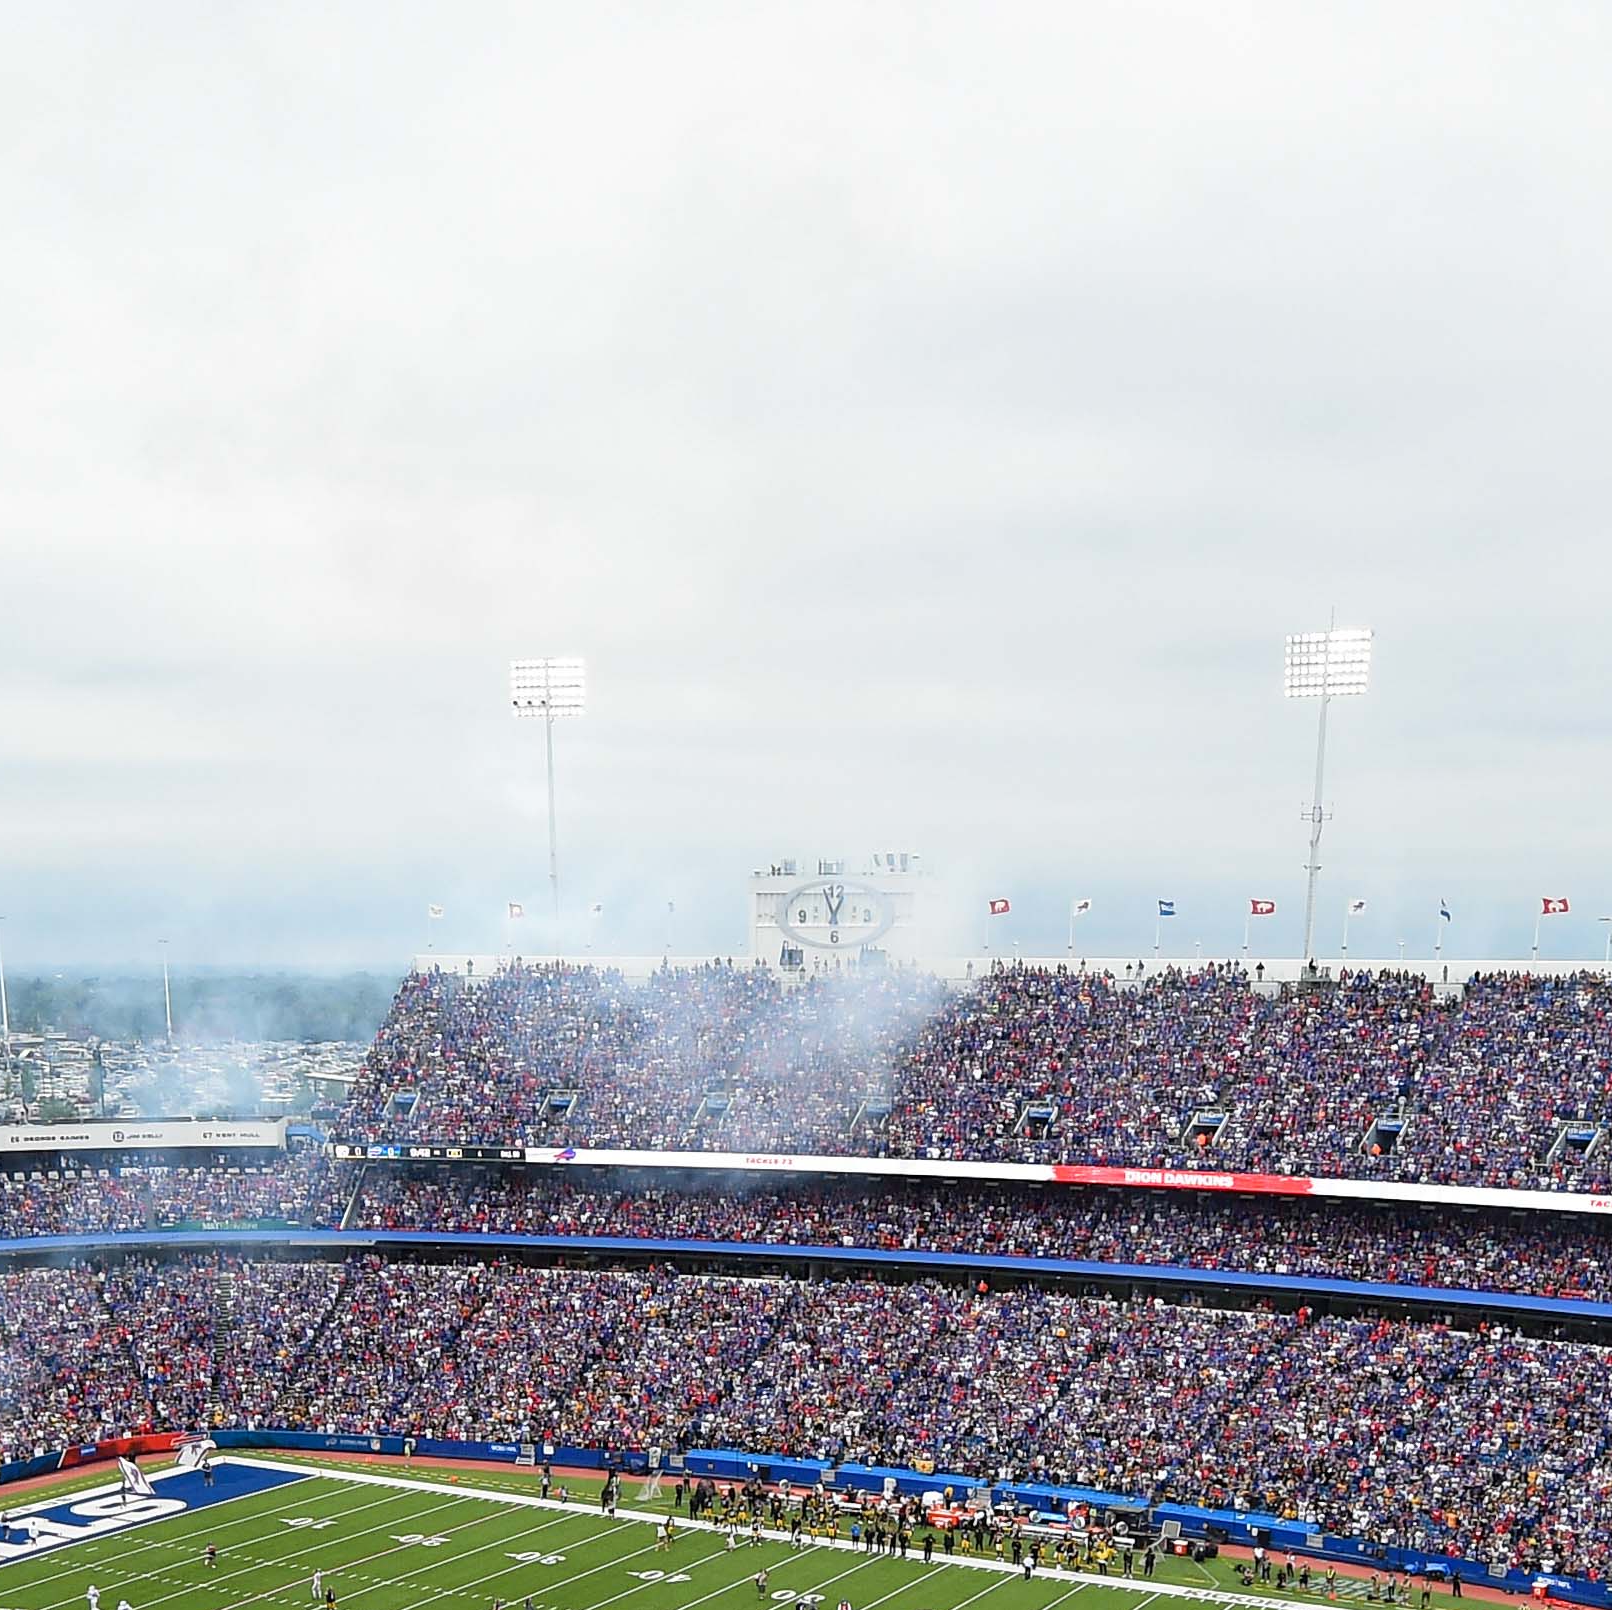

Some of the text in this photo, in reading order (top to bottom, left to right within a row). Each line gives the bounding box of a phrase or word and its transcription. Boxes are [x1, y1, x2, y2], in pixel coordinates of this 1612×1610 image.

[828, 885, 845, 898] 12
[798, 909, 807, 923] 9
[863, 909, 872, 922] 3
[829, 930, 839, 943] 6
[1124, 1169, 1235, 1188] DION DAWKINS
[1184, 1588, 1298, 1609] KICKOFF
